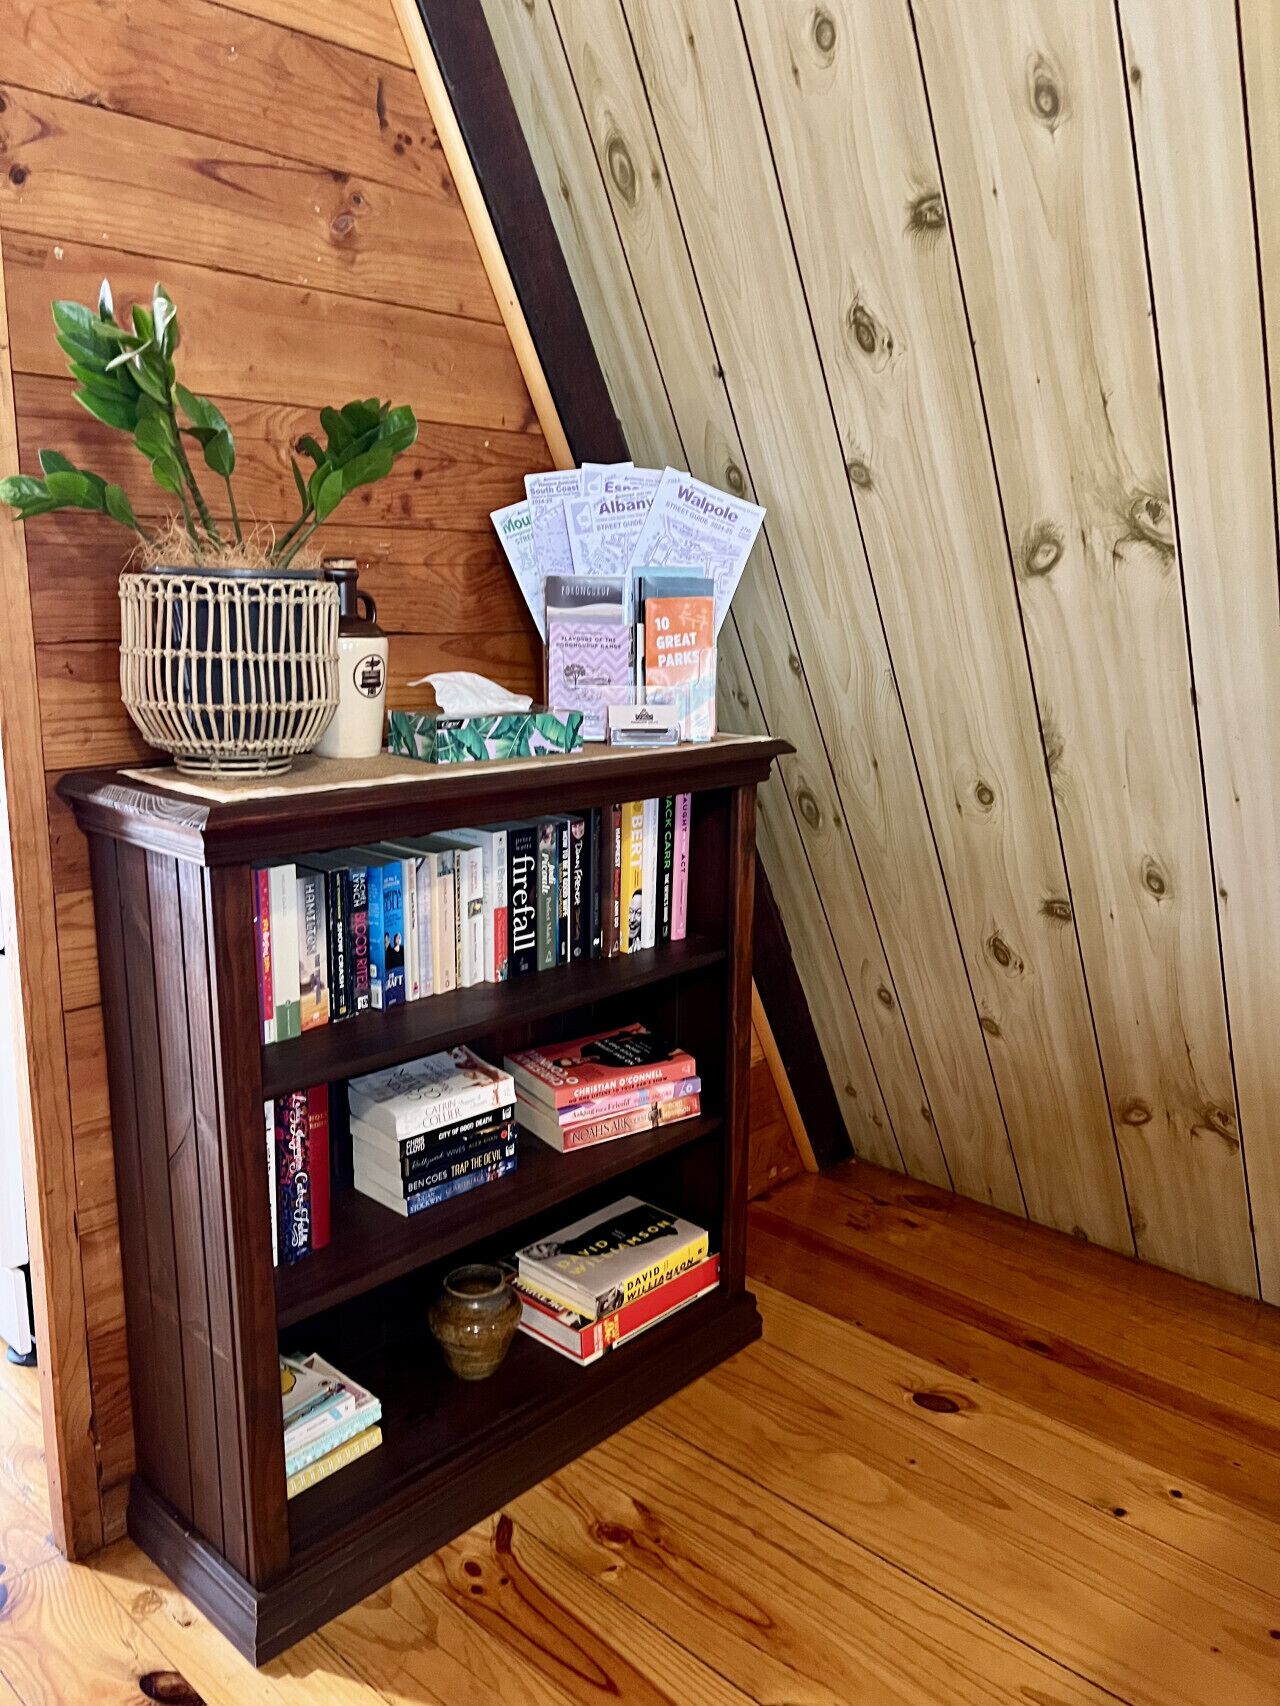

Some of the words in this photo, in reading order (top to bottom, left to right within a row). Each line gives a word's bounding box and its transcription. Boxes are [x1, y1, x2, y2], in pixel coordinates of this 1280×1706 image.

[599, 497, 653, 515] Albany
[677, 484, 739, 522] Walpole
[654, 617, 671, 632] 10
[656, 631, 697, 649] GREAT
[657, 650, 700, 668] PARKS
[631, 815, 643, 869] BERT
[664, 830, 672, 870] CARR
[352, 873, 361, 908] LYNCH
[541, 853, 551, 896] Picoult
[305, 883, 318, 956] HAMILTON
[512, 854, 536, 954] firefall
[574, 1079, 617, 1098] CHRISTIAN
[619, 1069, 663, 1087] O'CONNELL
[438, 1130, 452, 1141] CITY
[452, 1127, 460, 1136] OF
[408, 1179, 425, 1193] BEN
[425, 1169, 448, 1186] COES
[451, 1161, 470, 1178] TRAP
[470, 1155, 483, 1170] THE
[483, 1148, 503, 1167] DEVIL
[556, 1238, 609, 1269] DAVID
[566, 1218, 673, 1276] WILLIAMSON
[626, 1257, 695, 1302] WILLIAMSON
[627, 1266, 661, 1291] DAVID
